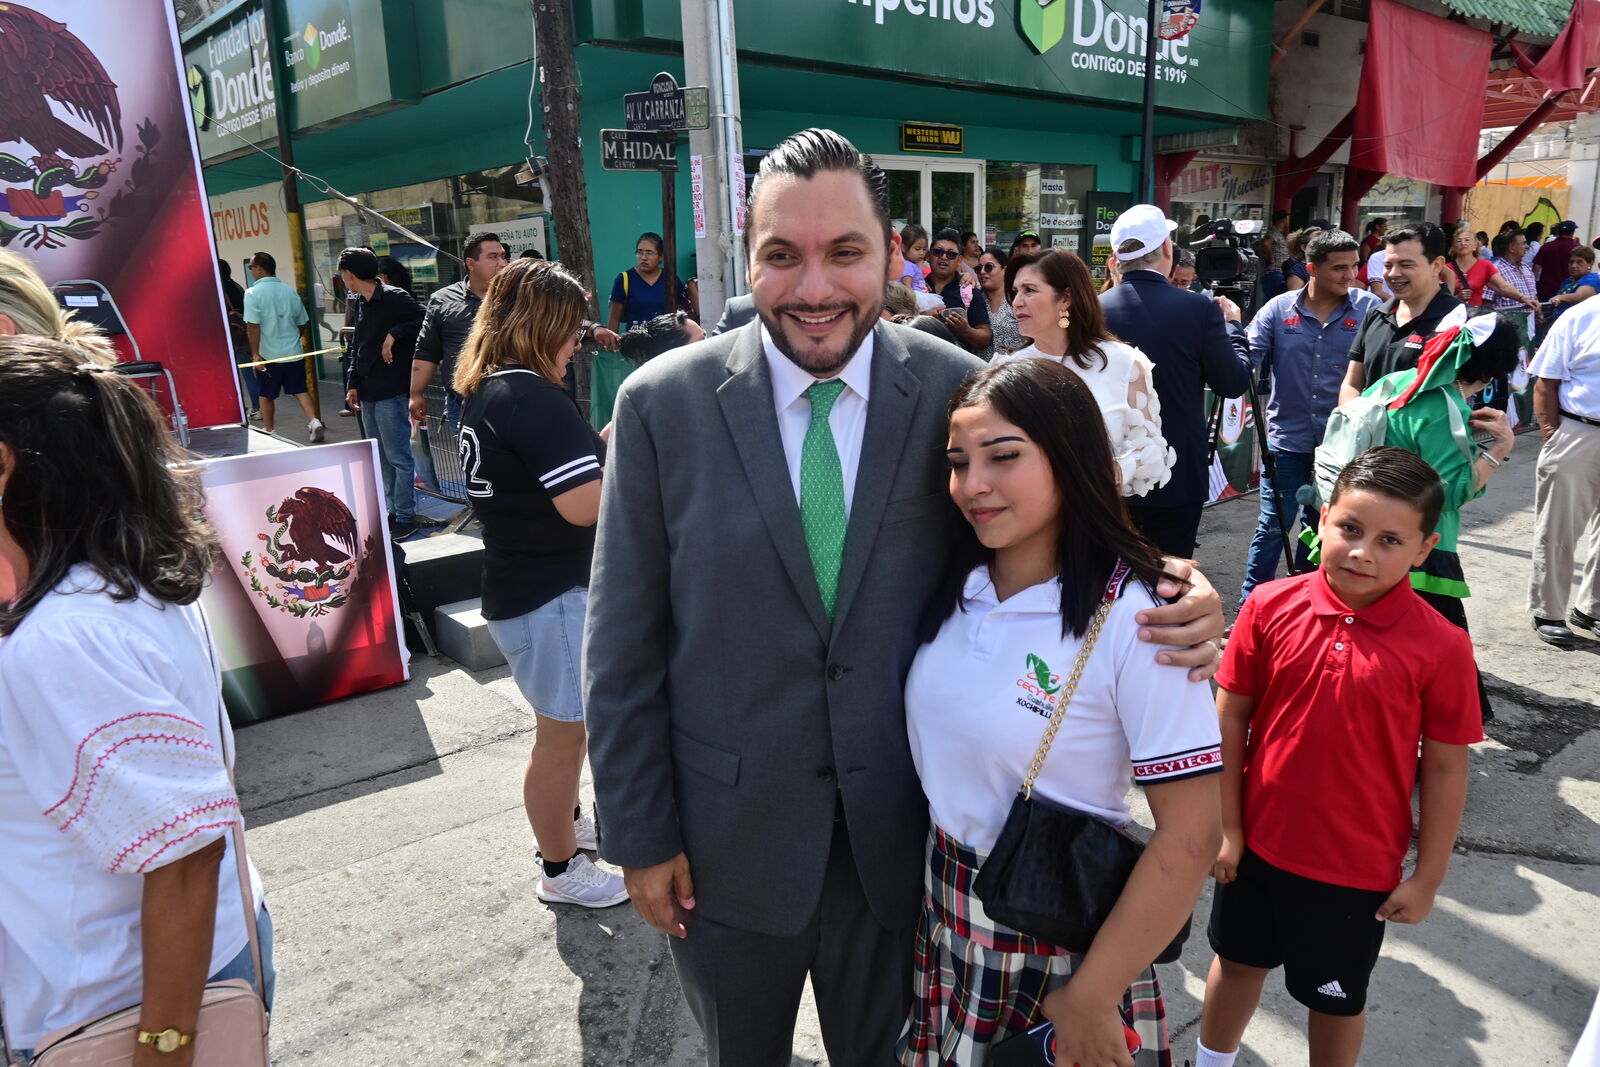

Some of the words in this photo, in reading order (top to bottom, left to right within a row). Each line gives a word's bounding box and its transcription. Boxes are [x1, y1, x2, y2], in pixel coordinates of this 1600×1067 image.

[319, 18, 347, 51] Dondé
[1073, 0, 1190, 65] Don
[1071, 52, 1125, 74] CONTIGO
[1127, 60, 1161, 80] DESE
[1164, 67, 1187, 84] 1919
[211, 41, 275, 120] Dondé
[644, 98, 685, 121] CARRANZA
[216, 118, 241, 138] CONTIGO
[240, 109, 262, 129] DESDE
[260, 102, 277, 121] 1919
[611, 131, 628, 140] CALLE
[906, 127, 939, 137] WESTERN
[916, 135, 939, 143] UNION
[614, 160, 636, 169] CENTRO
[1041, 182, 1063, 192] Hasta
[1041, 217, 1051, 226] De
[515, 229, 522, 239] TU
[523, 227, 538, 238] AUTO
[1053, 237, 1077, 248] Anillos
[460, 425, 494, 498] 2
[1016, 678, 1057, 704] CECYTE
[1136, 754, 1209, 776] CECYTEC
[1317, 986, 1347, 998] adidas
